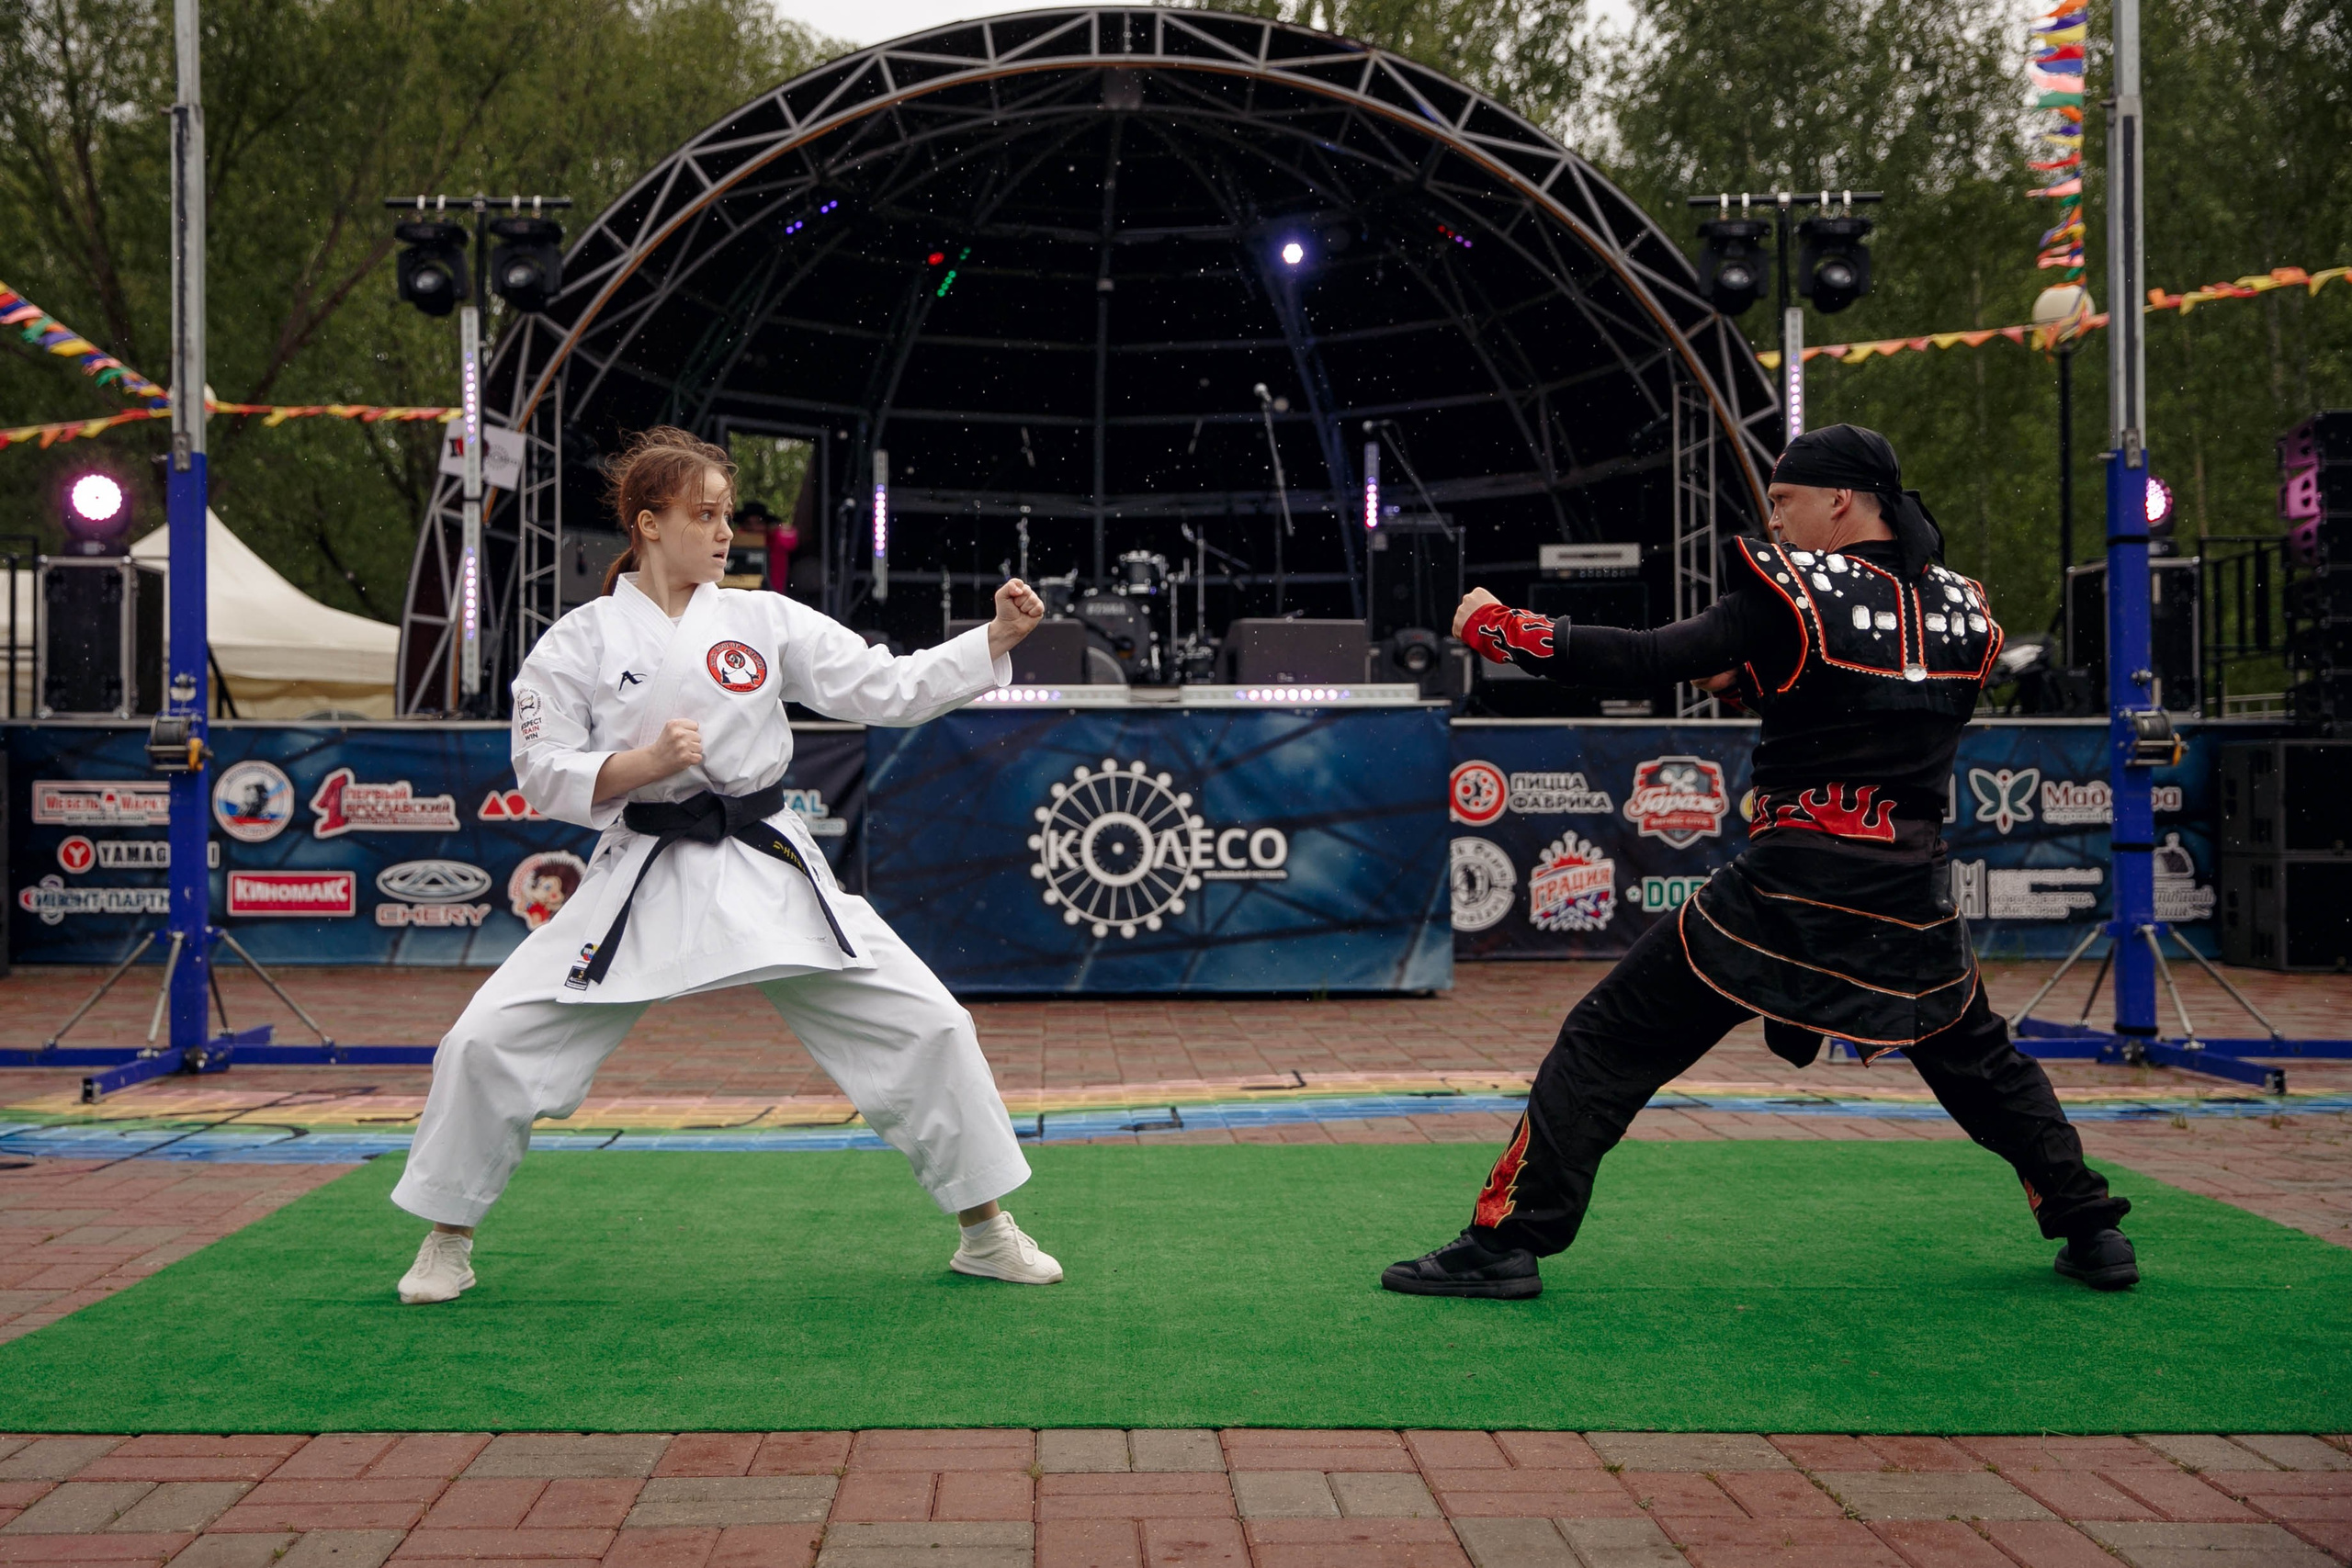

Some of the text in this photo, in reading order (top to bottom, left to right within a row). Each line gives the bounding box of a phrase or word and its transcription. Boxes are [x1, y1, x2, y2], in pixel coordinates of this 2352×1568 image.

[525, 732, 538, 741] WIN
[1516, 775, 1585, 790] ПИЦЦА
[1513, 795, 1608, 808] ФАБРИКА
[1048, 812, 1288, 886] КОЛЕСО
[1534, 868, 1611, 910] ГРАЦИЯ
[379, 904, 489, 925] CHERY
